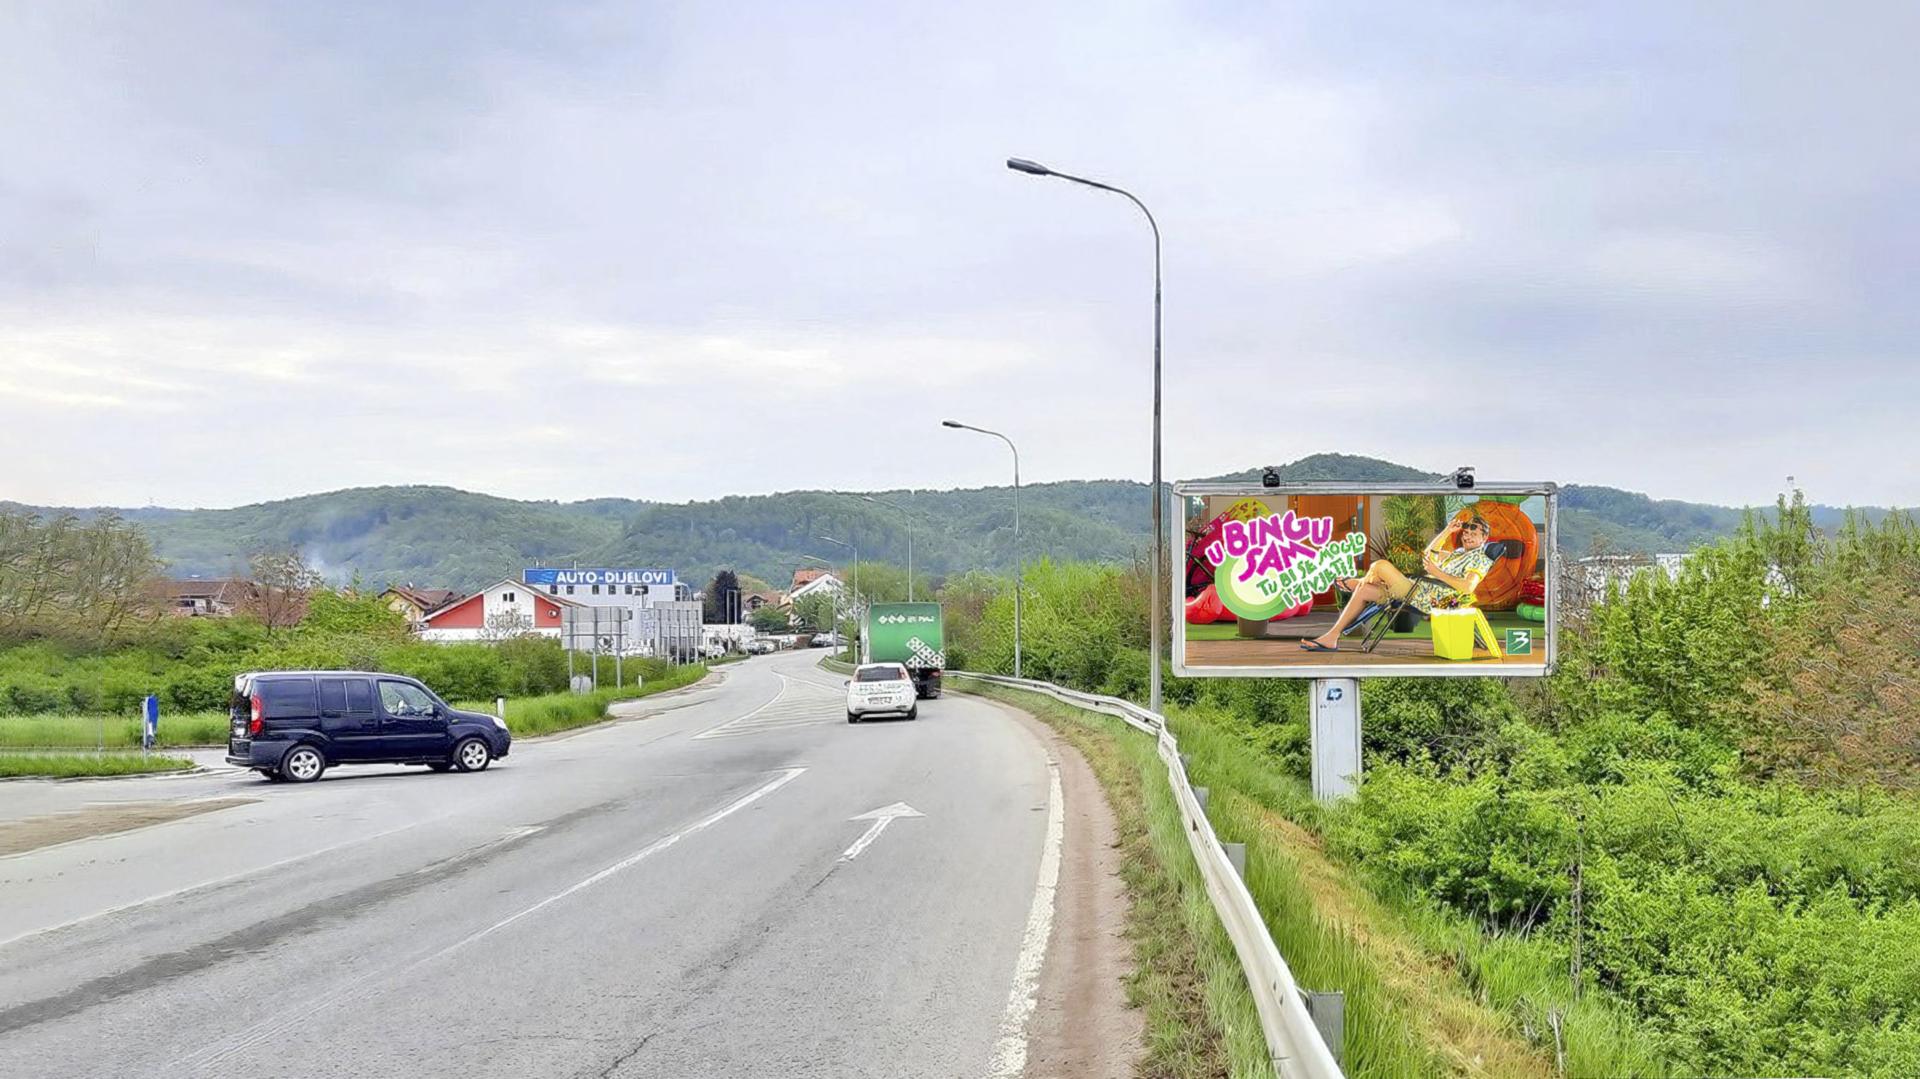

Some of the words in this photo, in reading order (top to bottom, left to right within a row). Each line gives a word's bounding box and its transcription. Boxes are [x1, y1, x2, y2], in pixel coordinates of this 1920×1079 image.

[1206, 541, 1225, 566] U
[1223, 510, 1332, 556] BINGU
[1238, 540, 1317, 583] SAM
[556, 571, 668, 584] AUTO-DIJELOVI
[1256, 578, 1278, 597] TU
[1279, 568, 1298, 588] BI
[1297, 558, 1318, 579] SE
[1317, 532, 1366, 566] MOGLO
